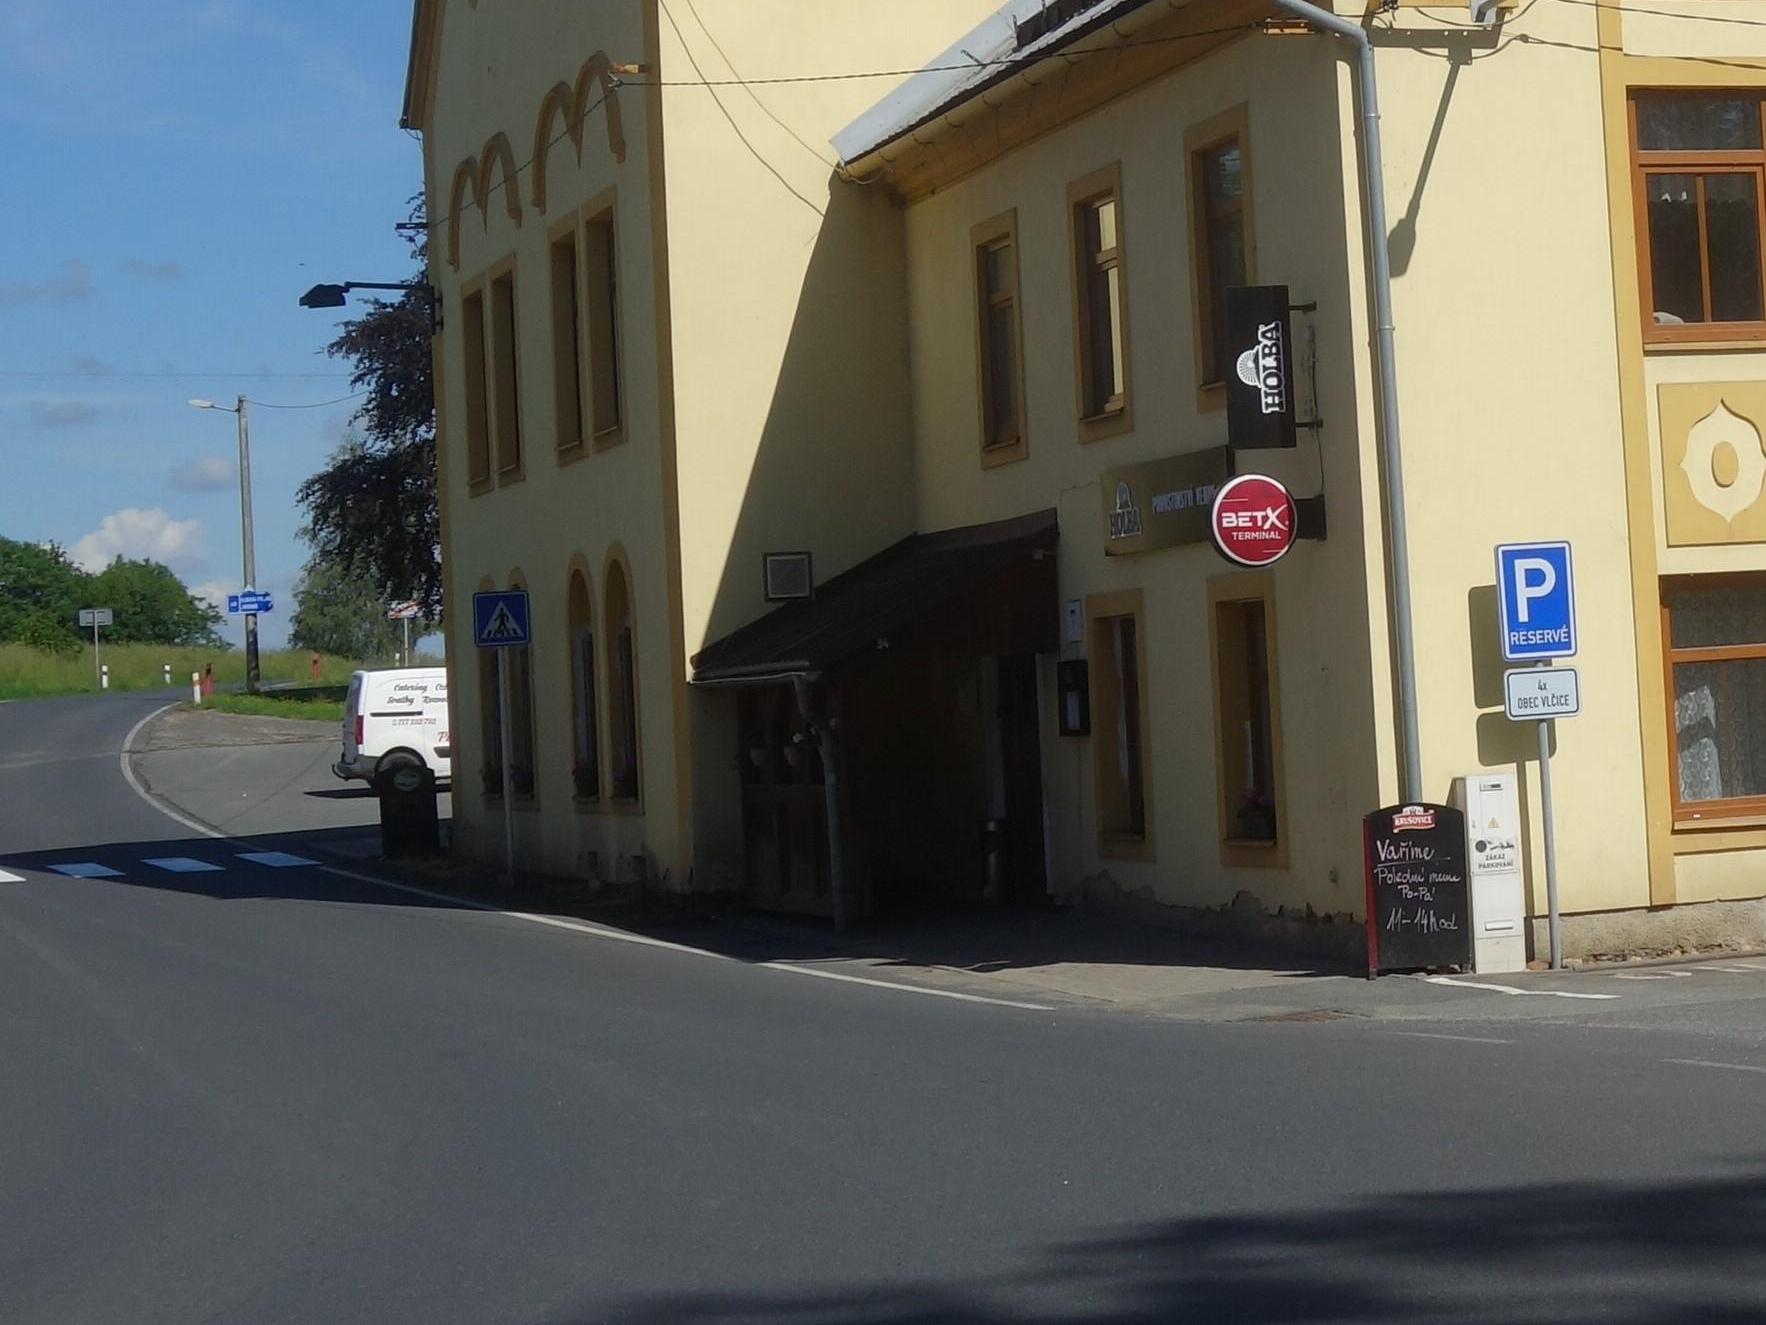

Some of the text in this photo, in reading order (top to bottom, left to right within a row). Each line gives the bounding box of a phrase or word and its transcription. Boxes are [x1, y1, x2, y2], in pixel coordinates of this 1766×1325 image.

[1257, 320, 1286, 414] HOLBA
[1221, 504, 1289, 531] BETX
[1231, 530, 1281, 541] TERMINAL
[1513, 557, 1556, 623] P
[1510, 625, 1569, 646] RESERVÉ
[1517, 693, 1570, 710] OBEC VLČICE
[1376, 839, 1435, 861] Vaříme
